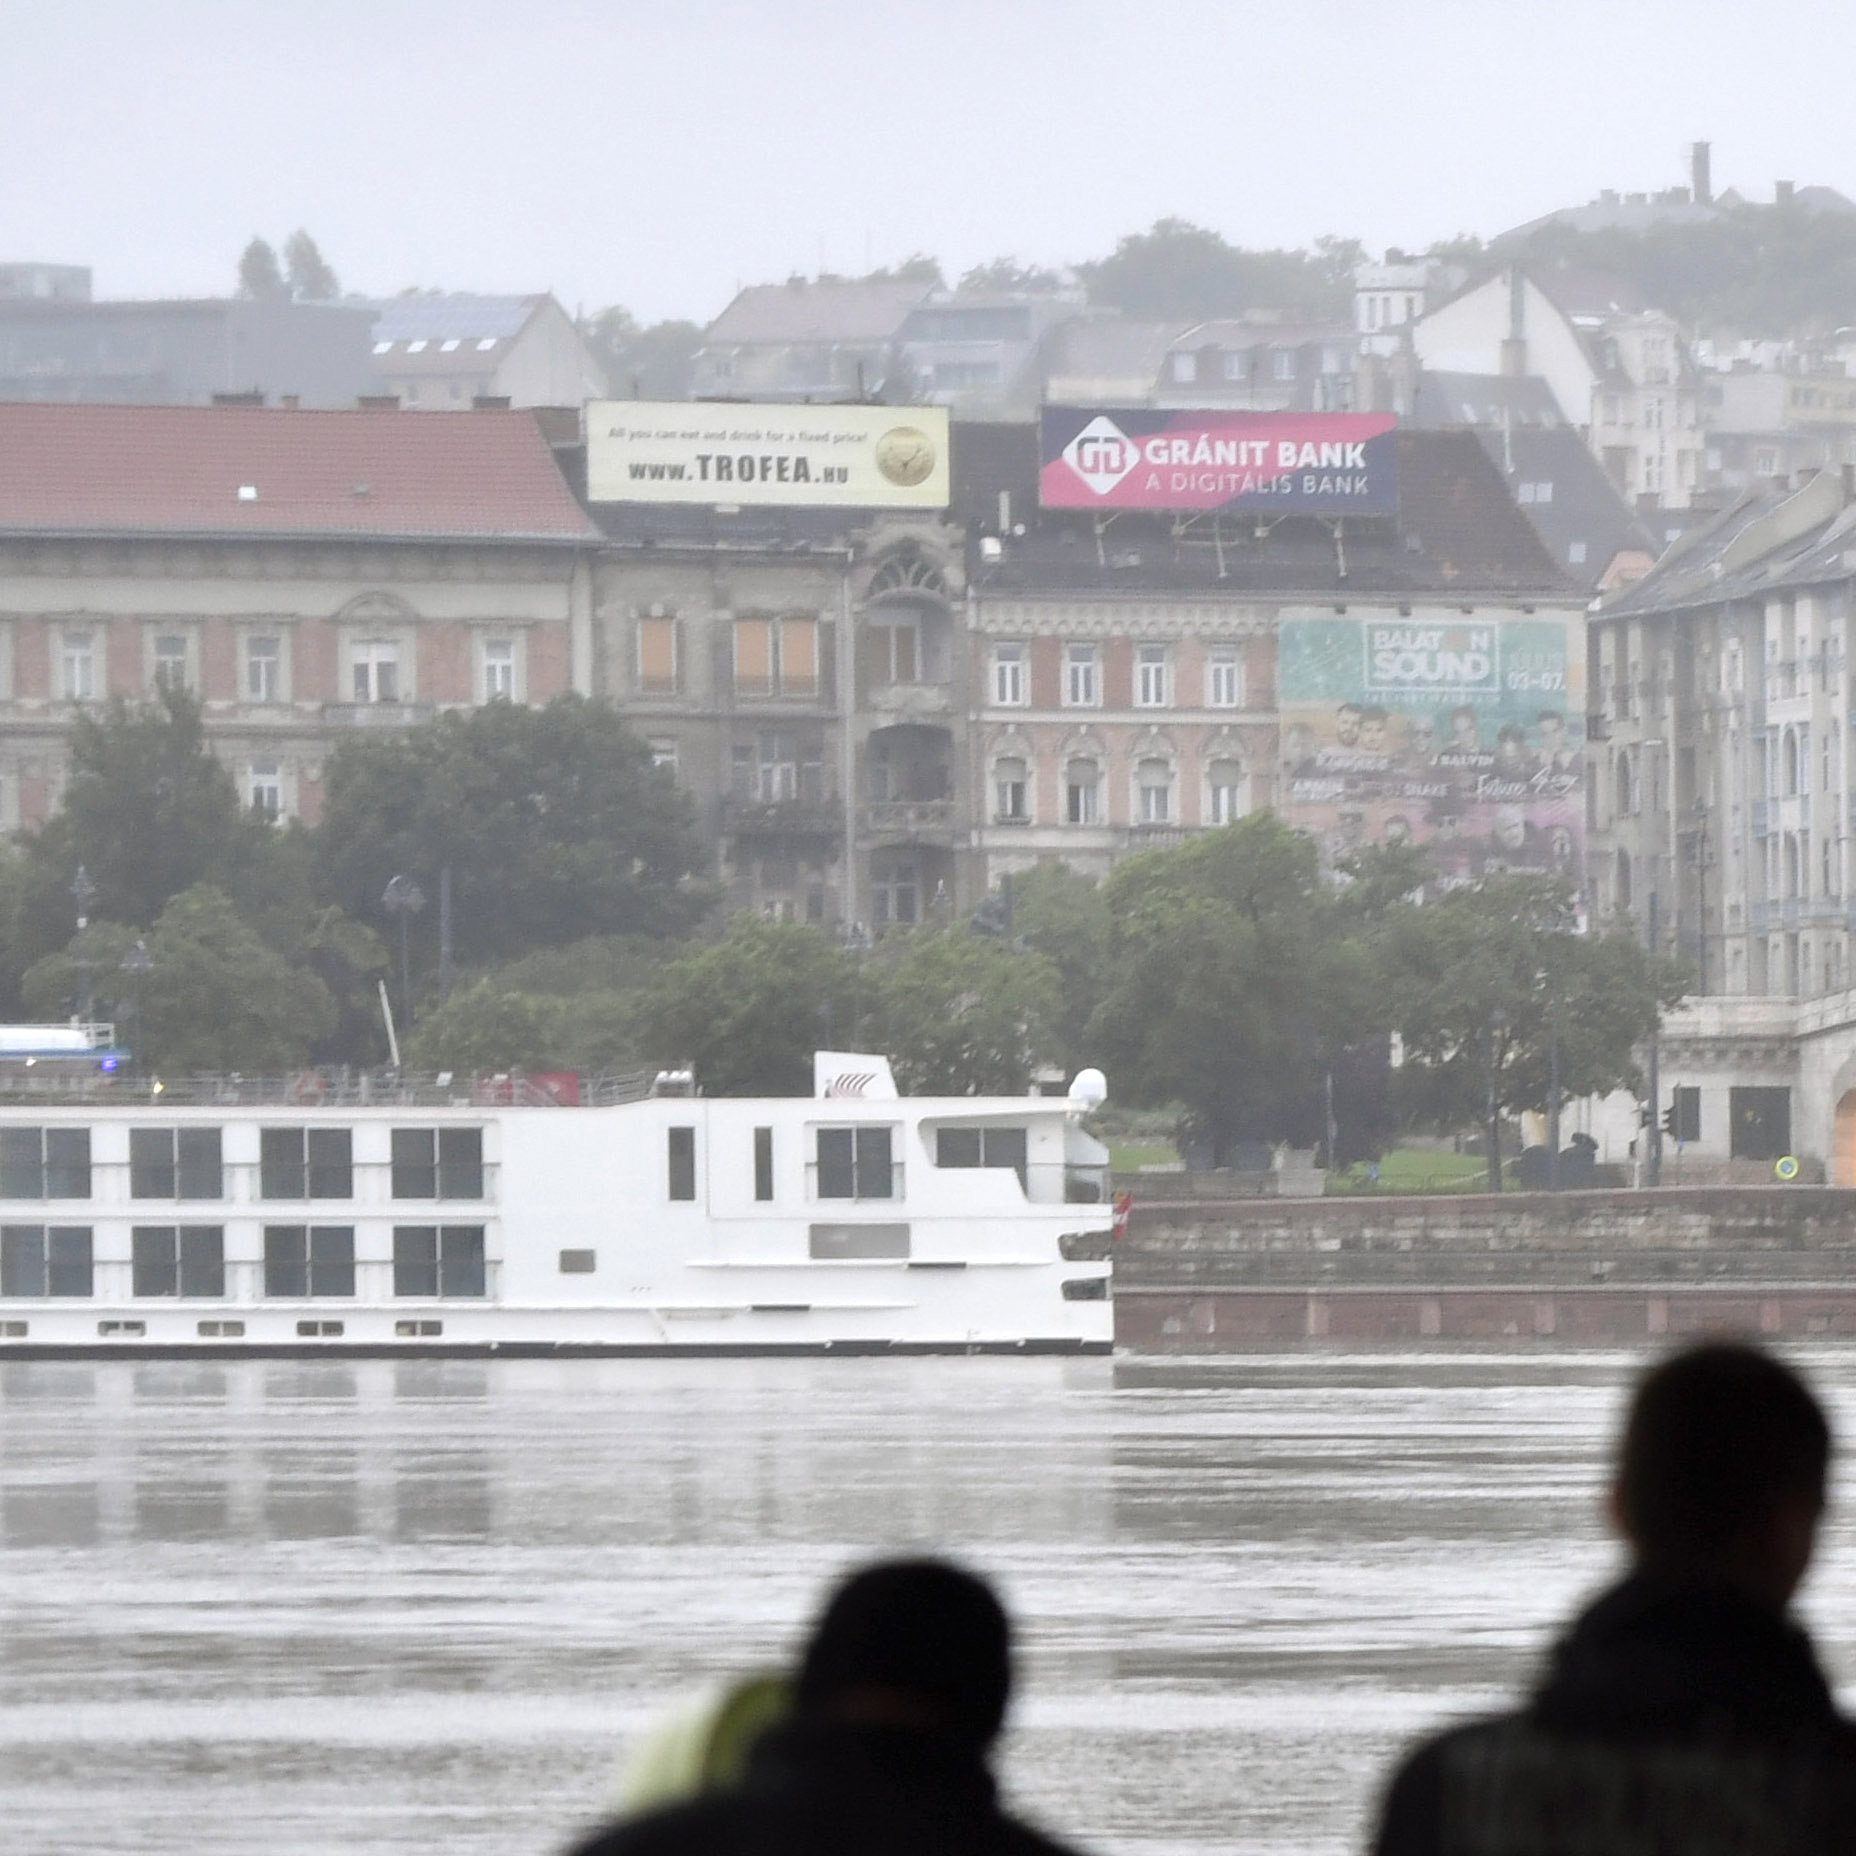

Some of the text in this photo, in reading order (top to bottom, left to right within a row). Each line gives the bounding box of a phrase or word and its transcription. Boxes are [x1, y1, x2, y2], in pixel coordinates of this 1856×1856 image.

[608, 426, 868, 445] All you can eat and drink for a fixed price!
[1146, 433, 1366, 468] GRÁNIT BANK
[628, 454, 850, 485] www.TROFEA.HU
[1146, 470, 1369, 495] A DIGITÁLIS BANK
[1373, 650, 1490, 682] SOUND
